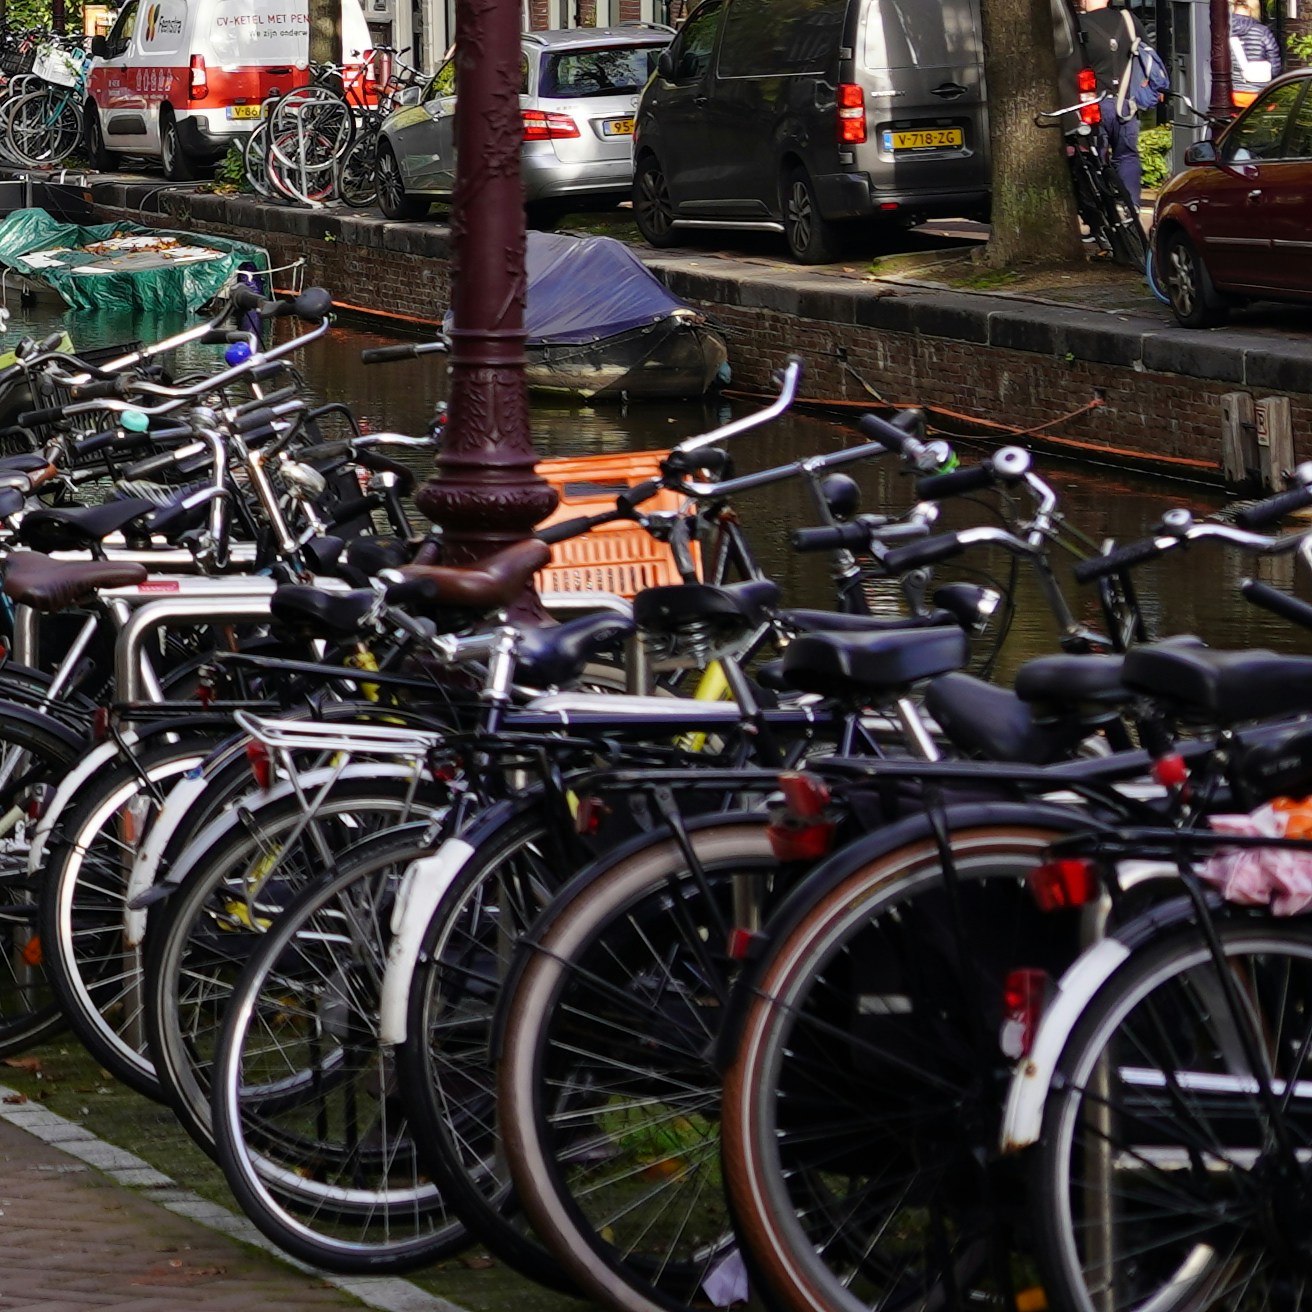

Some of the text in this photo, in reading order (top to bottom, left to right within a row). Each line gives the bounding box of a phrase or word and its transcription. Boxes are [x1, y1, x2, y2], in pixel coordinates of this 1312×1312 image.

[216, 15, 264, 27] CV-KETEL
[267, 14, 287, 24] MET
[898, 131, 955, 146] V-718-ZG
